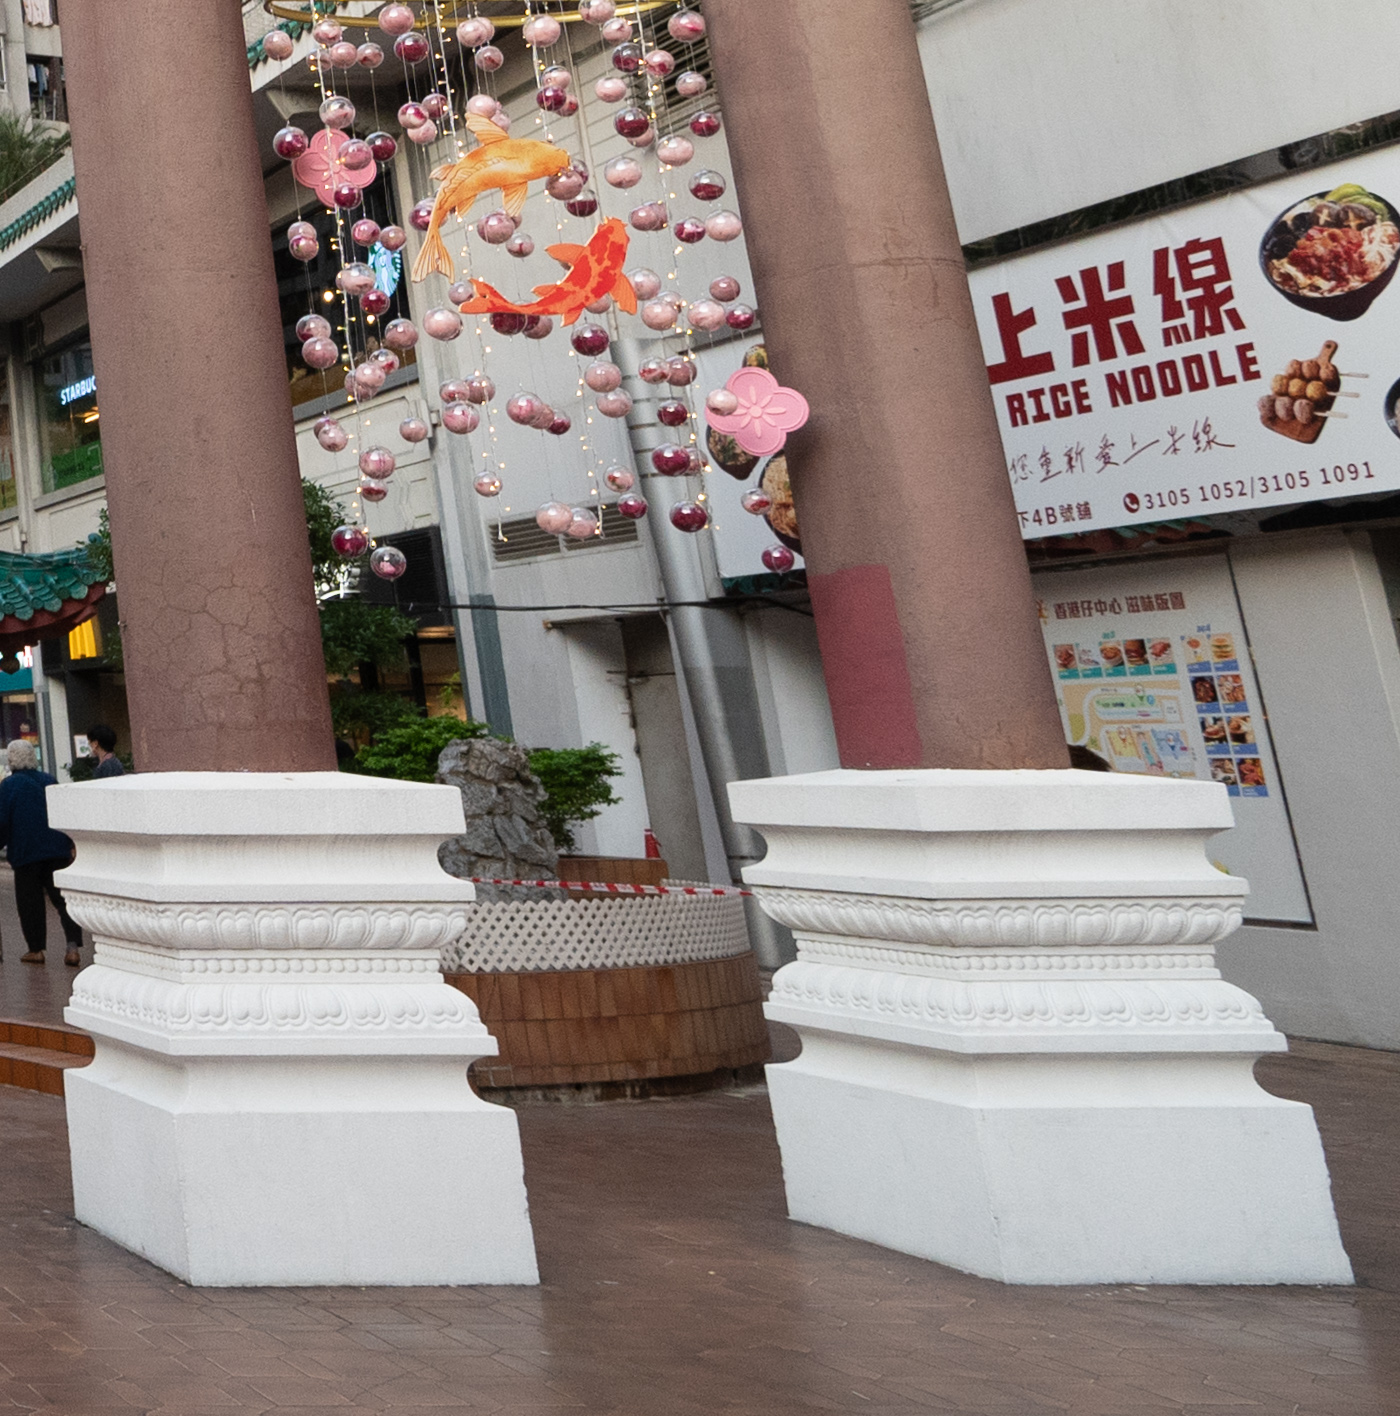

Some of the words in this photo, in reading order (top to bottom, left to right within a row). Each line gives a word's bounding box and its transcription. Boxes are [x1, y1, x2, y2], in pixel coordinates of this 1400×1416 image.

[985, 236, 1247, 386] 上米線
[1005, 378, 1094, 428] RICE
[1104, 341, 1262, 409] NOODLE
[1143, 487, 1191, 511] 3105
[1198, 469, 1311, 502] 1052/3105
[1319, 460, 1376, 486] 1091
